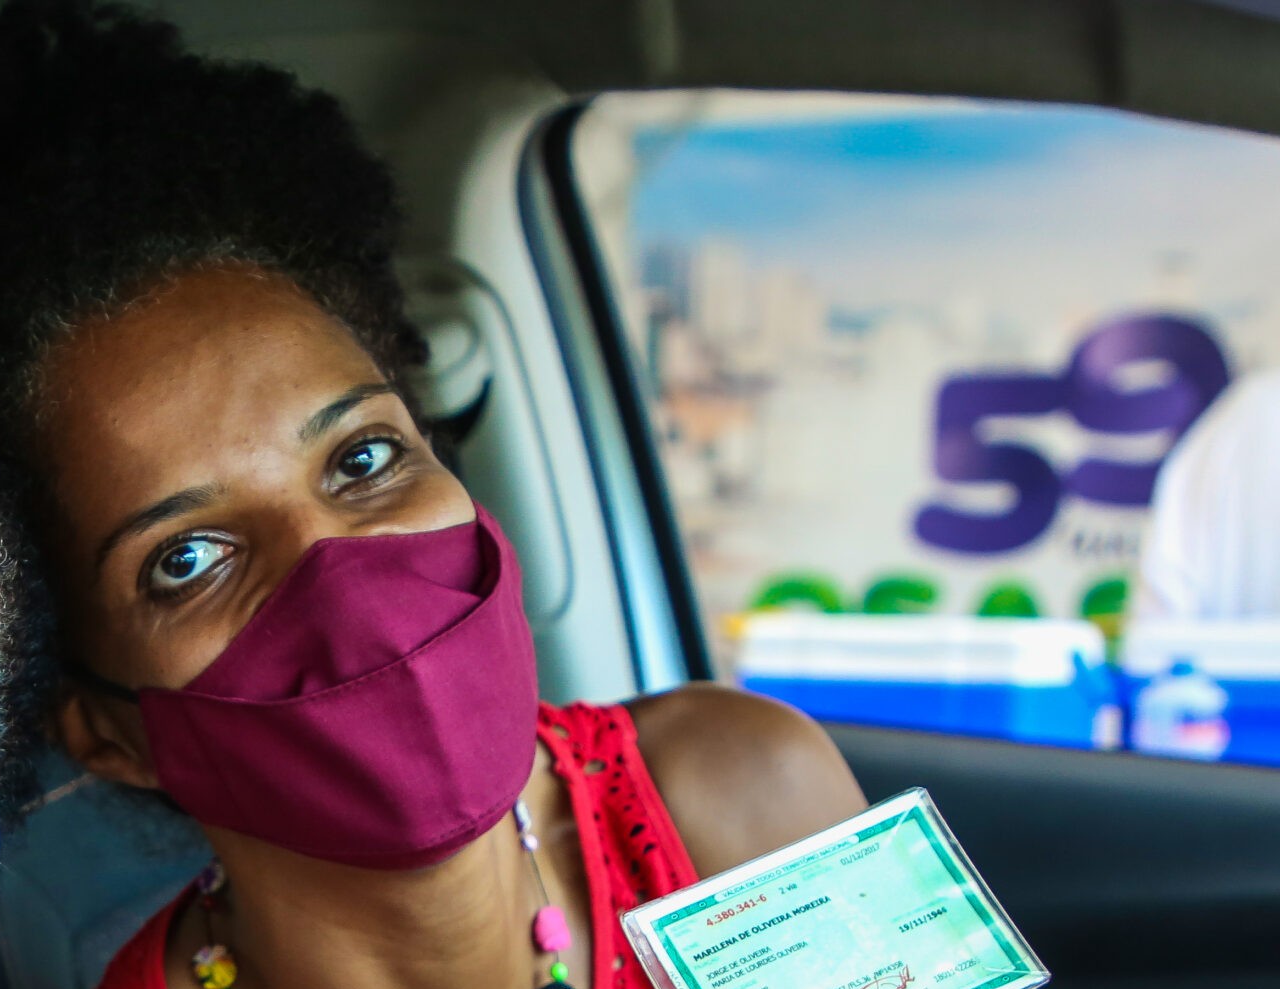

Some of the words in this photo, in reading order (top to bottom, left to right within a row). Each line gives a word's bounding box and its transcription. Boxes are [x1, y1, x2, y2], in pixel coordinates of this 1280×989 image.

[693, 937, 738, 962] MARILENA
[738, 930, 751, 941] DE
[751, 912, 793, 934] OLIVEIRA
[792, 895, 832, 916] MOREIRA
[705, 894, 767, 927] 4.380.341-6
[706, 967, 728, 982] JORGE
[728, 961, 739, 970] DE
[739, 946, 773, 965] OLIVEIRA
[711, 975, 736, 989] MARIA
[735, 970, 744, 979] DE
[745, 955, 777, 974] LOURDES
[776, 941, 809, 959] OLIVEIRA
